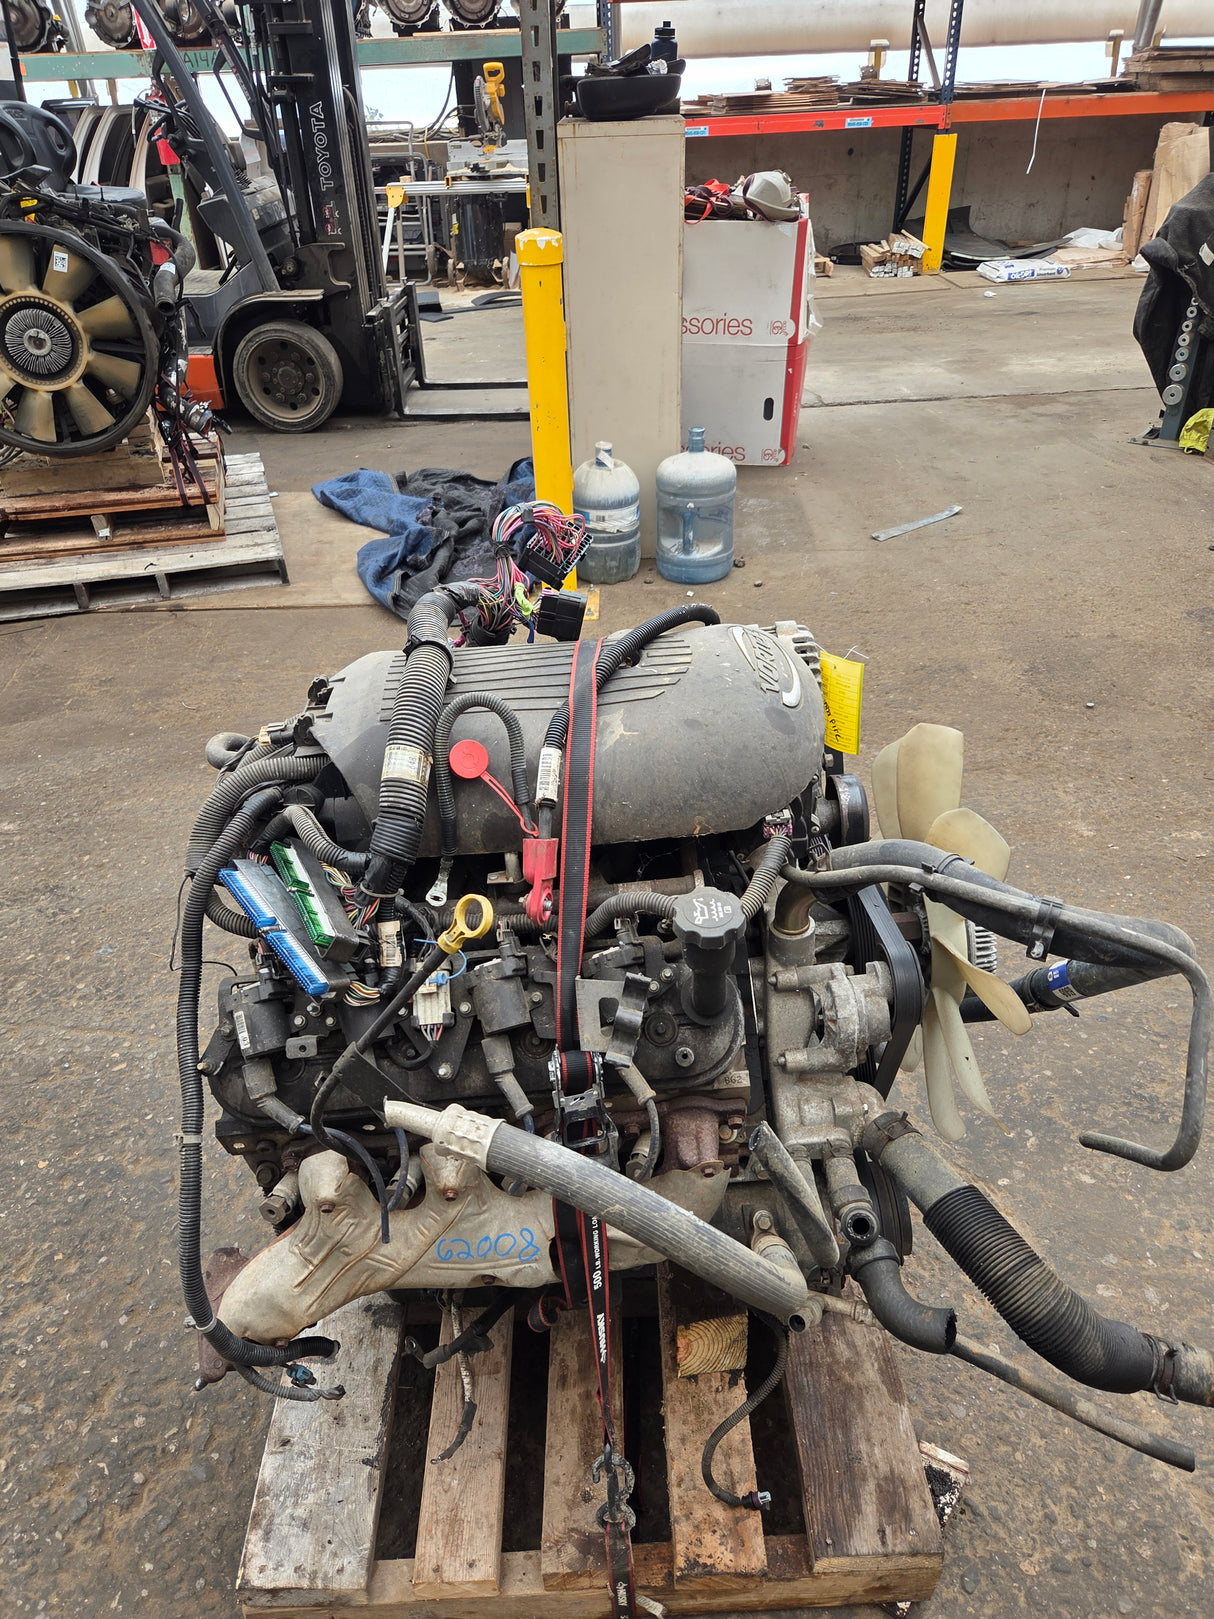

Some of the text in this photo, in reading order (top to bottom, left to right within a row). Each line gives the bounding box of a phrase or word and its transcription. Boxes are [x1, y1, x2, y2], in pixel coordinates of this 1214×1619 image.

[309, 101, 334, 191] TOYOTA
[436, 1227, 540, 1262] 62008
[592, 1229, 601, 1259] WORKING
[592, 1269, 603, 1291] 500
